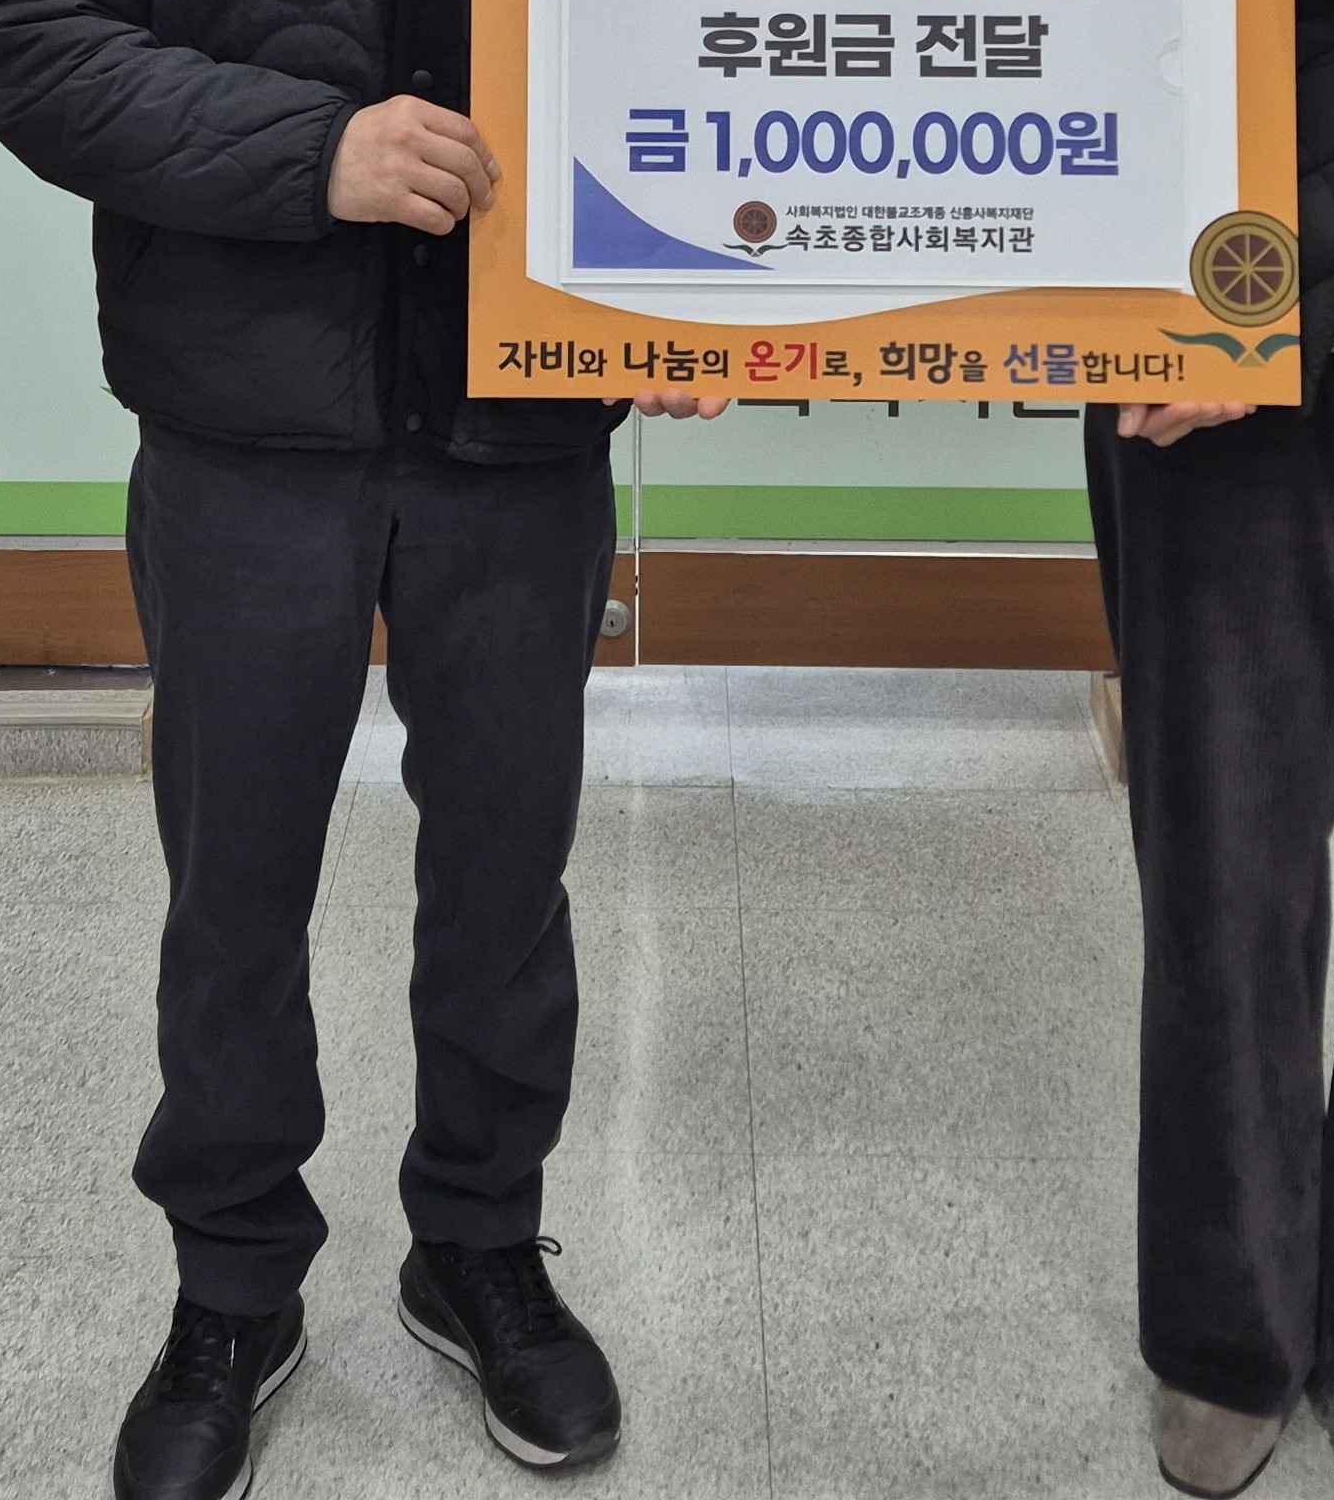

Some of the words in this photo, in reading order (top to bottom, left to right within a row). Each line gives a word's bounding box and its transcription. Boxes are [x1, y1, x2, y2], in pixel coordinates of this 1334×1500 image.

[698, 12, 896, 78] 후원금
[915, 14, 1049, 79] 전달
[625, 108, 690, 173] 금
[705, 110, 1120, 179] 1,000,000원
[785, 205, 858, 219] 사회복지법인
[861, 205, 946, 220] 대한불교조계종
[949, 206, 1035, 221] 신흥사복지재단
[785, 223, 1035, 254] 속초종합사회복지관
[498, 340, 608, 379] 자비와
[624, 340, 729, 382] 나눔의
[744, 340, 862, 387] 온기로,
[880, 341, 987, 384] 희망을
[1001, 342, 1185, 385] 선물합니다!
